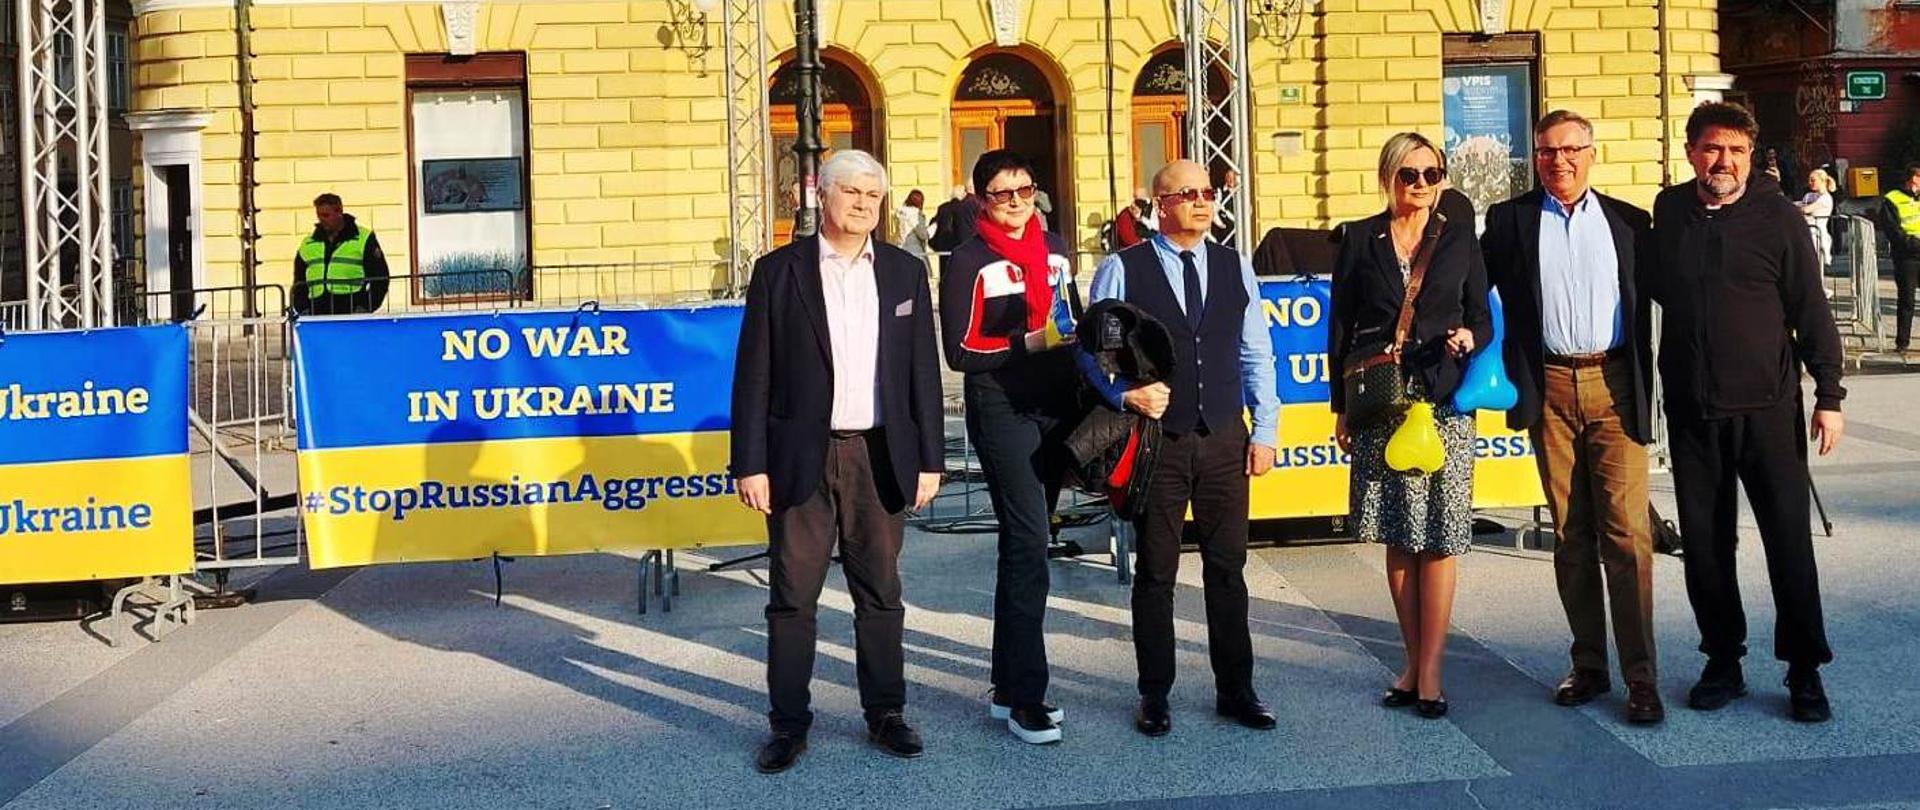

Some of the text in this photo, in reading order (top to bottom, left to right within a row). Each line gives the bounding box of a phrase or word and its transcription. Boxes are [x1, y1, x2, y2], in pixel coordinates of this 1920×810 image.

[1463, 75, 1491, 86] VPIS
[1261, 296, 1321, 328] NO
[442, 324, 630, 360] NO WAR
[0, 380, 149, 421] kraine
[407, 381, 674, 422] IN UKRAINE
[305, 471, 737, 521] #StopRussianAggressi
